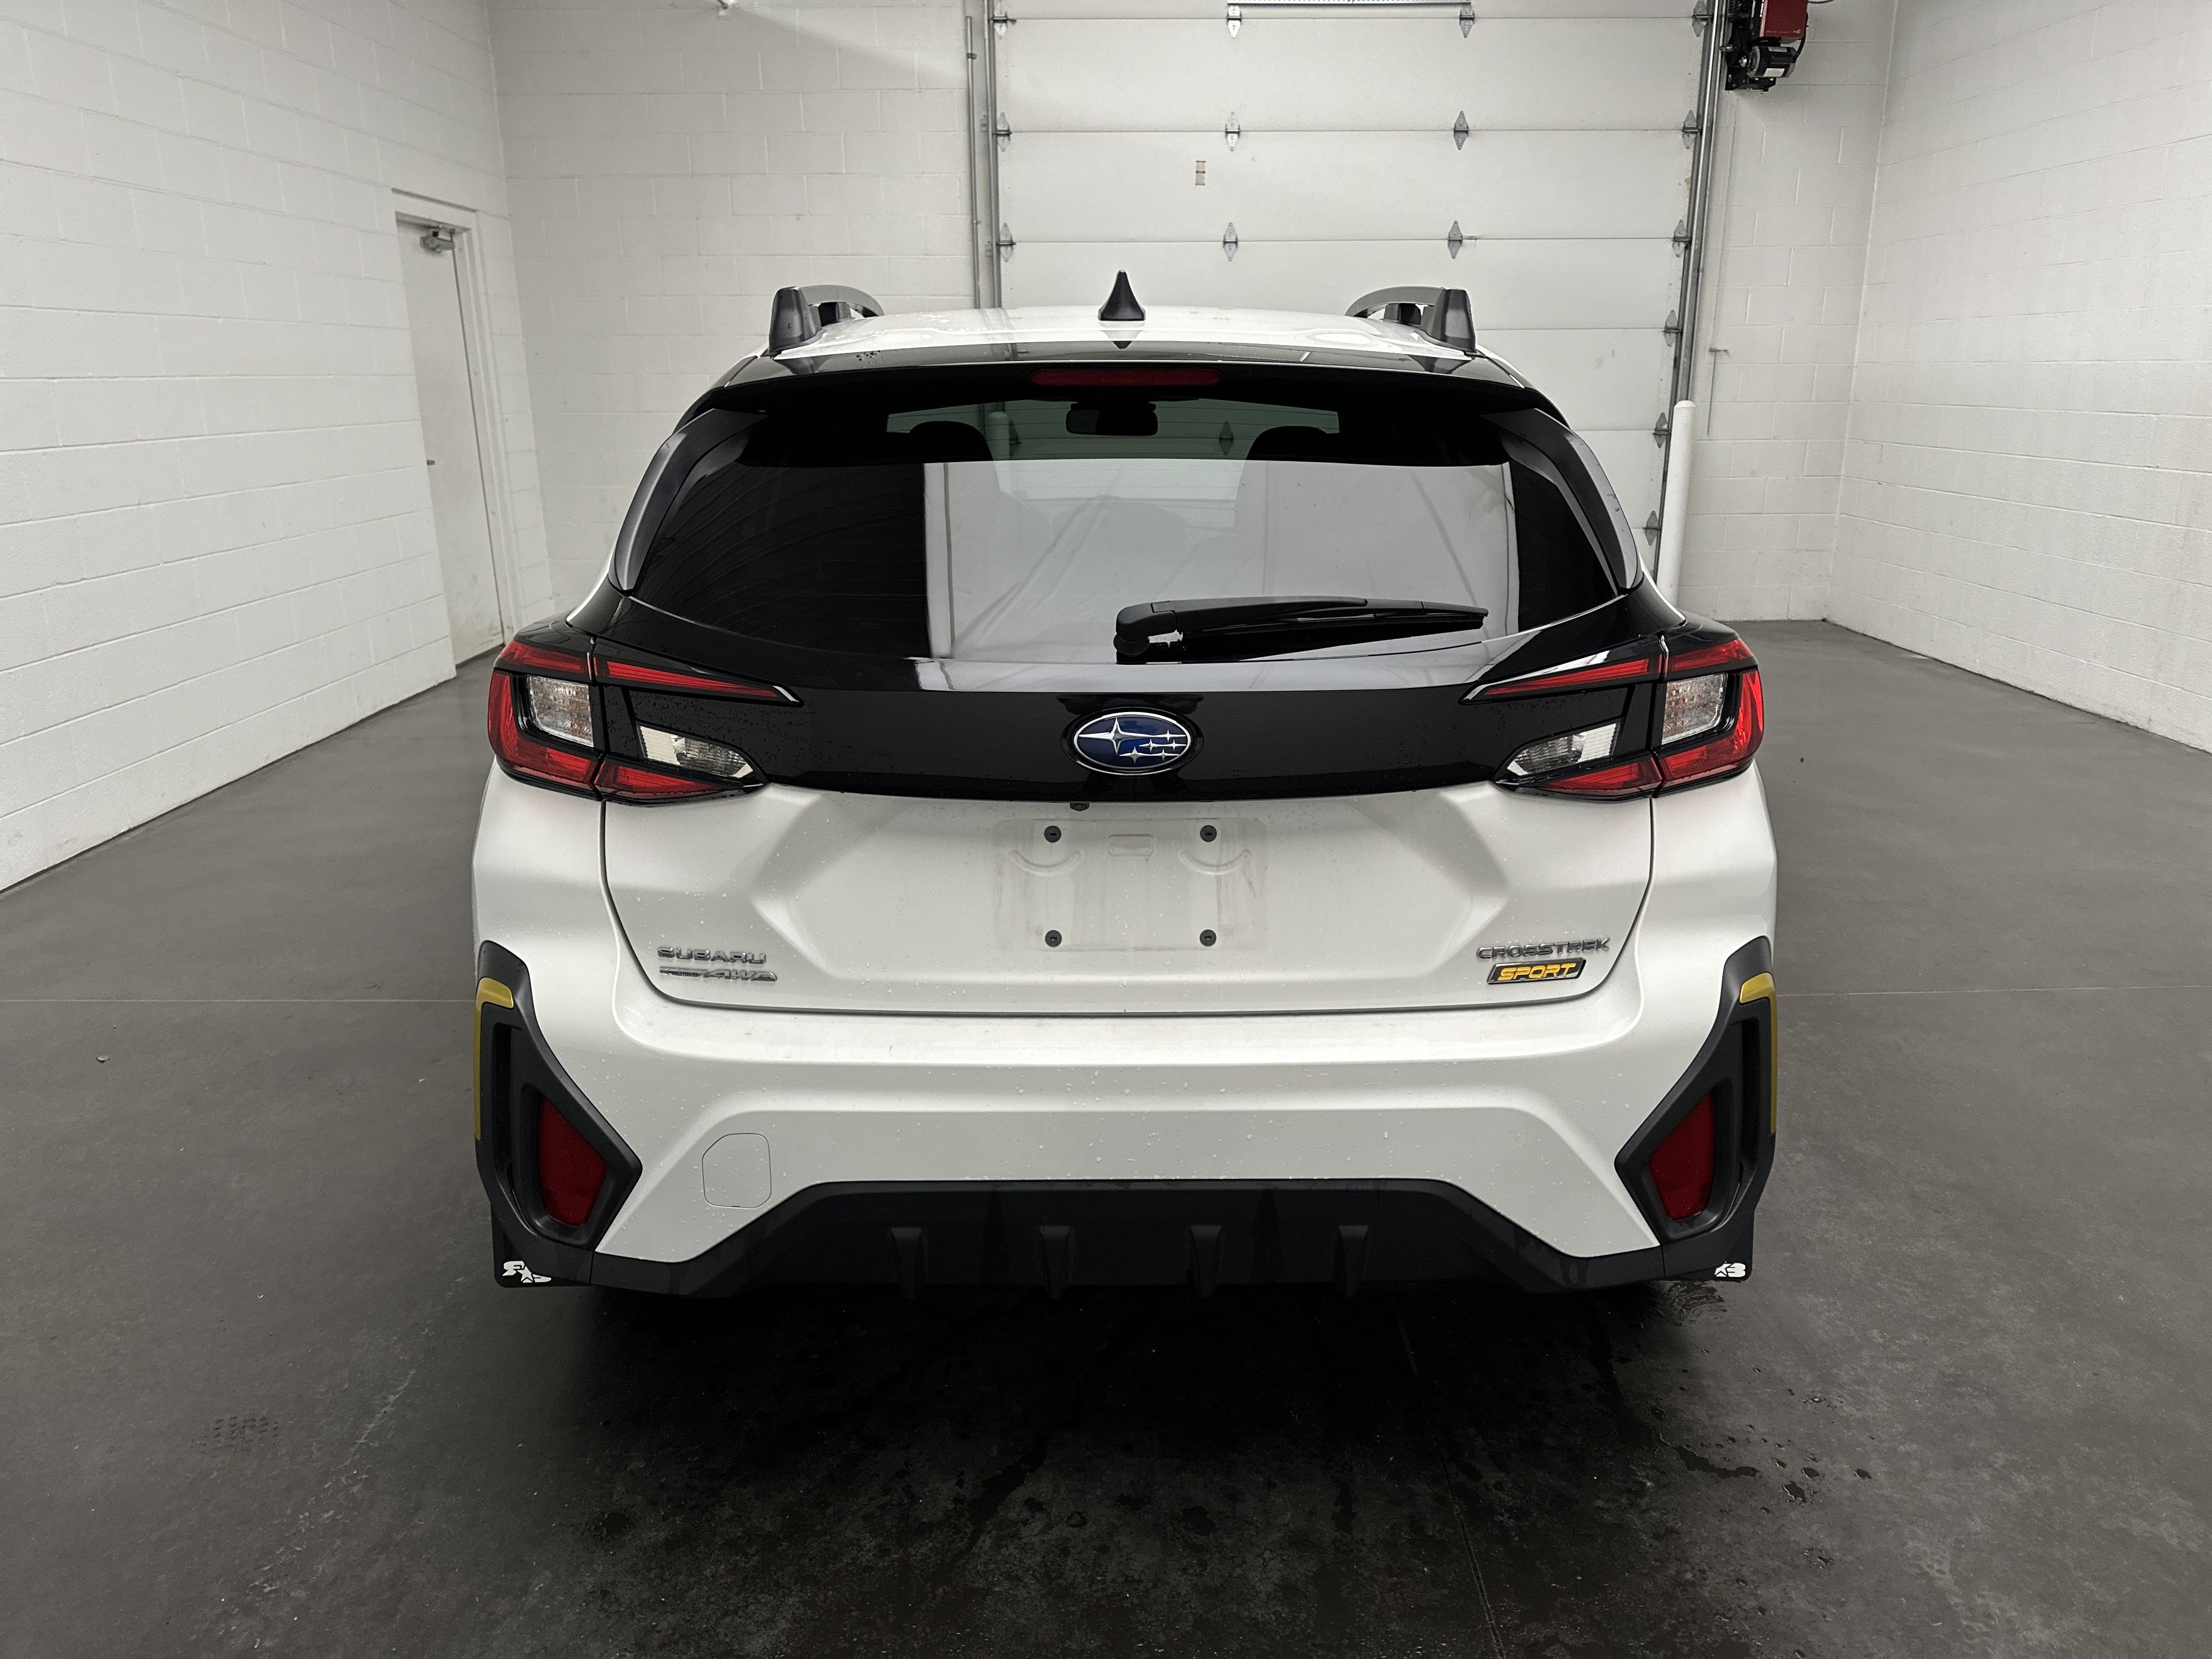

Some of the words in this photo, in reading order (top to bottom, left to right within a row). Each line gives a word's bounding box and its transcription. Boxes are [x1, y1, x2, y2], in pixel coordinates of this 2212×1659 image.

[657, 946, 766, 964] SUBARU
[1477, 938, 1611, 959] CROSSTREK
[703, 969, 777, 981] AWD
[1498, 963, 1576, 981] SPORT
